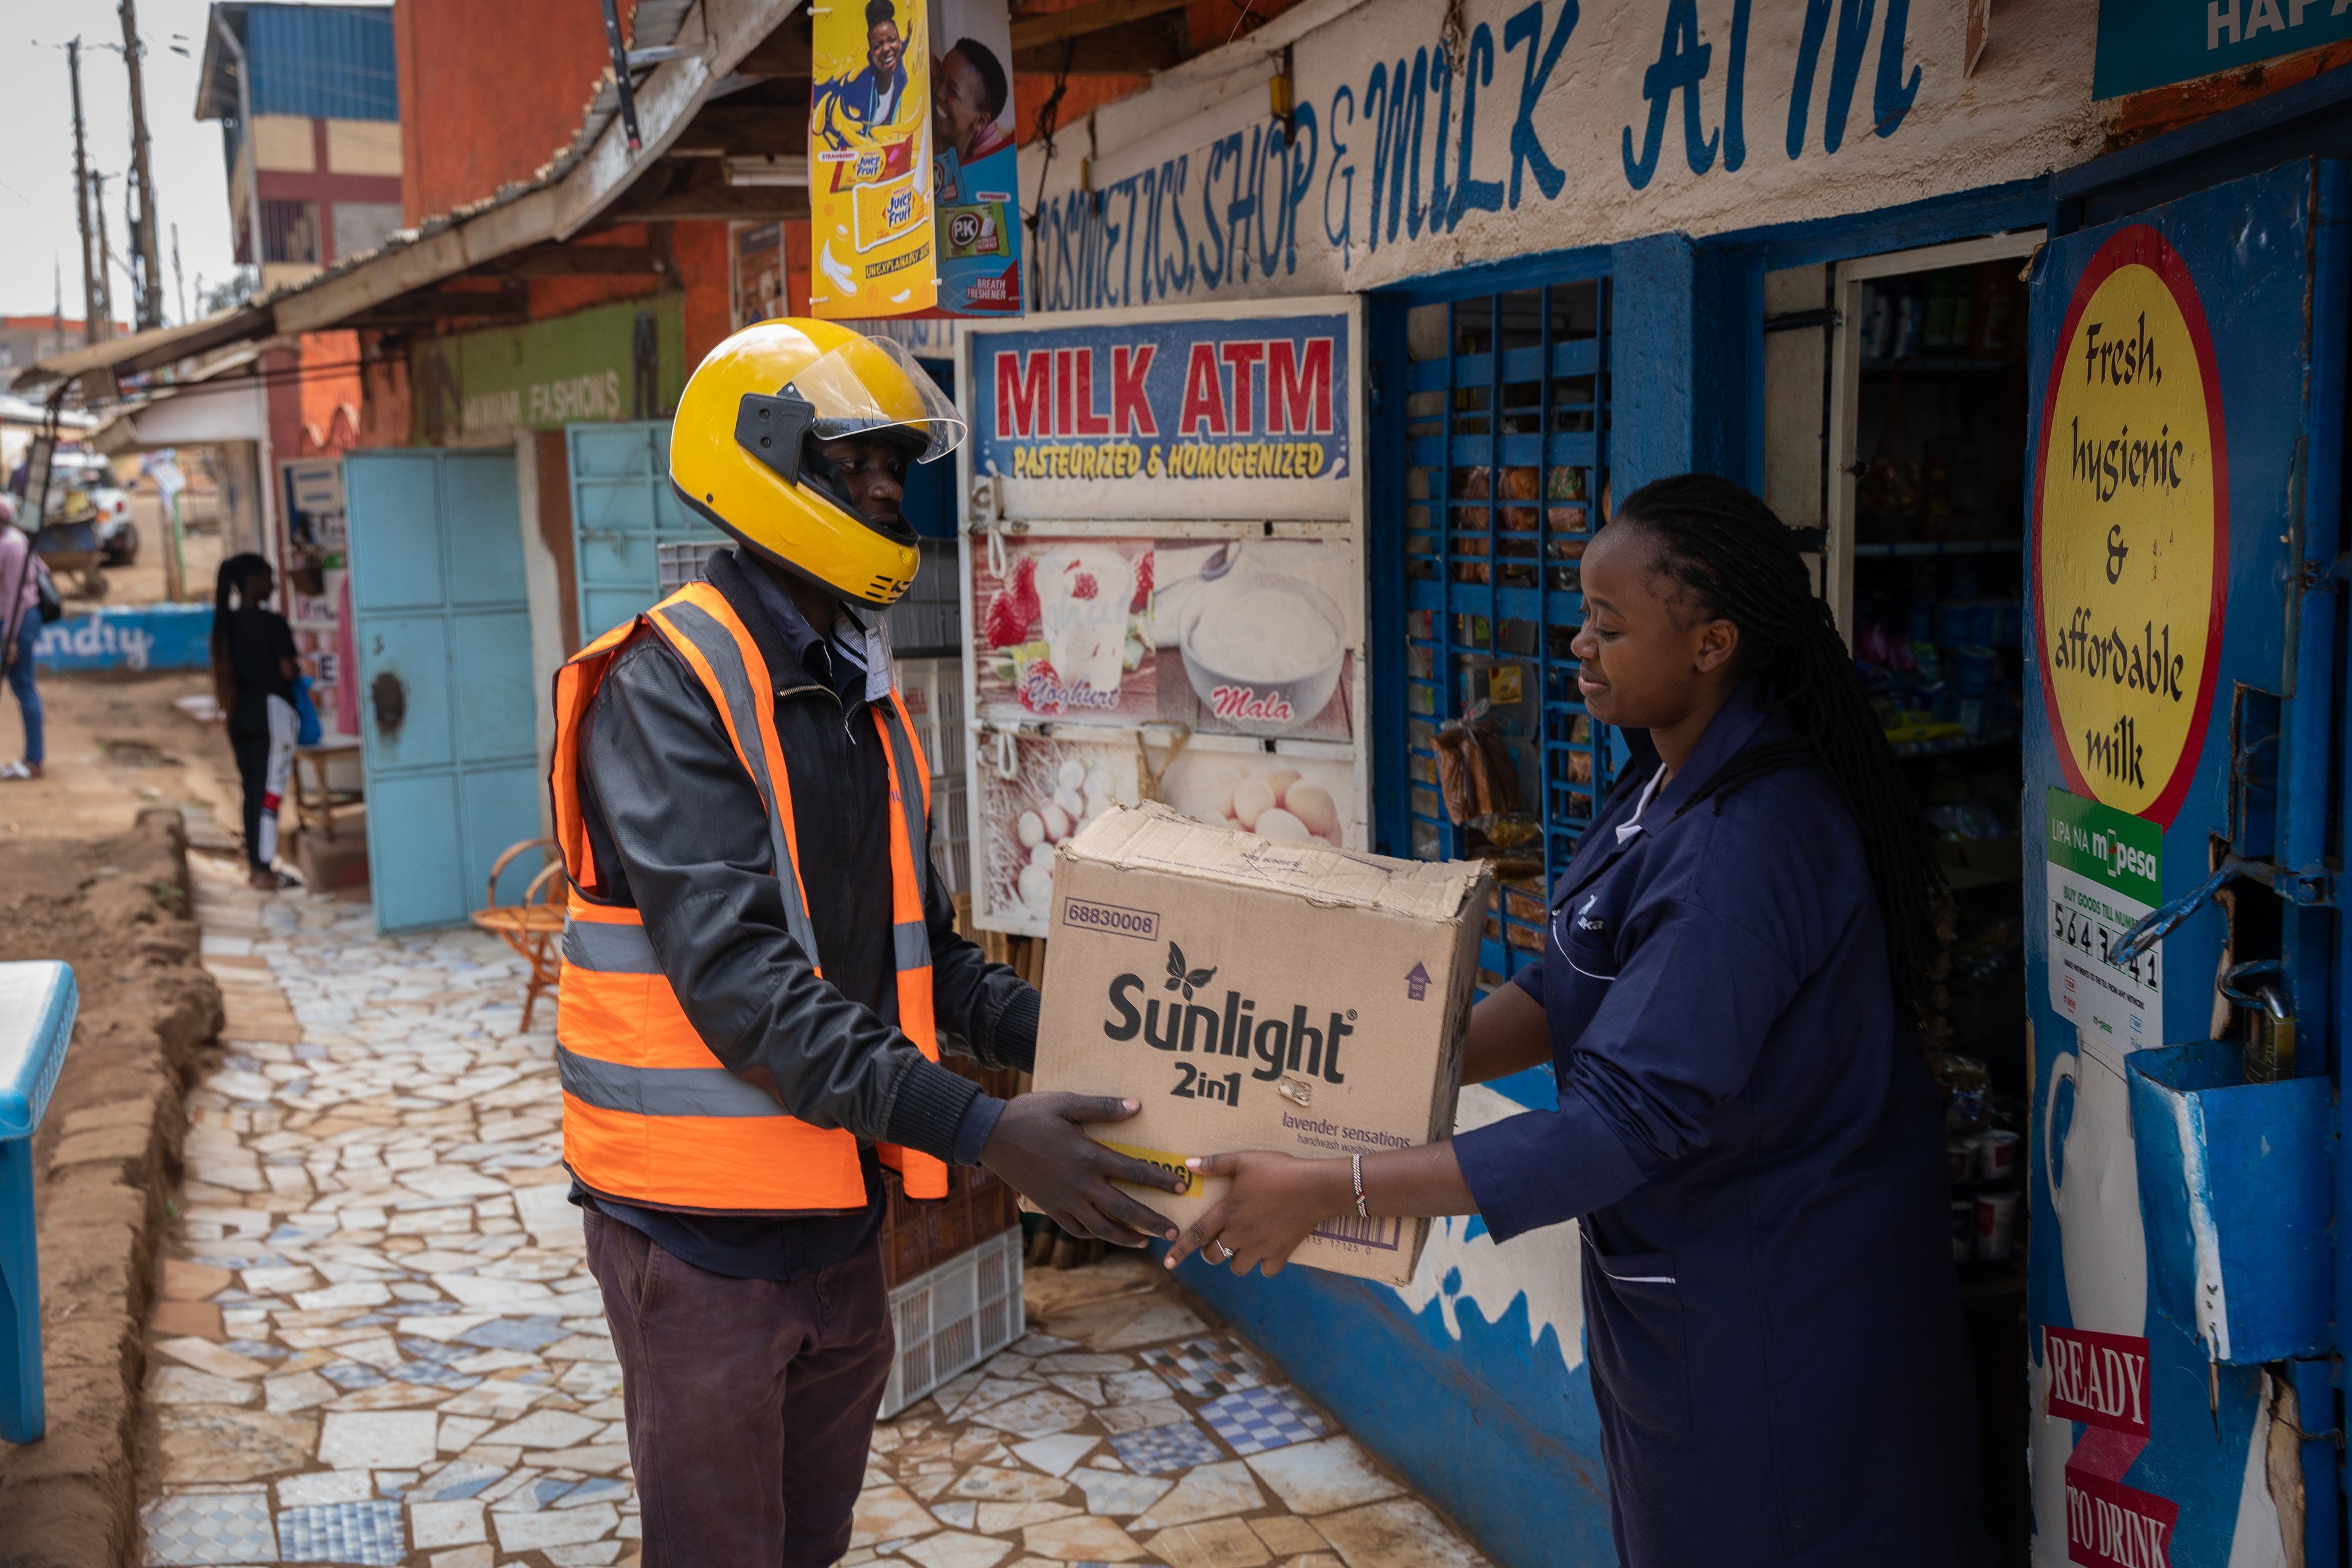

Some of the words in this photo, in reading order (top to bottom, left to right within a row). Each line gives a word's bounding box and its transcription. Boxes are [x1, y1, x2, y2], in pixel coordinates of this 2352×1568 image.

[1198, 101, 1319, 289] SHOP
[1324, 85, 1354, 271] &
[1363, 0, 1580, 254] MILK
[967, 288, 1006, 300] FRESHENER
[977, 278, 1006, 289] BREATH
[2085, 310, 2162, 386] Fresh,
[530, 370, 620, 419] FASHIONS
[995, 344, 1159, 440] MILK
[1178, 337, 1335, 437] ATM
[1012, 444, 1142, 480] PASTEURIZED
[1146, 445, 1162, 477] &
[1166, 442, 1324, 478] HOMOGENIZED
[2071, 416, 2183, 502] hygienic
[2106, 524, 2128, 585] &
[2055, 606, 2183, 703] affordable
[1028, 676, 1119, 710] Yoghurt
[1212, 685, 1293, 722] Mala
[2085, 715, 2144, 791] milk
[2052, 818, 2071, 847] LIPA
[2074, 824, 2089, 854] NA
[1068, 903, 1153, 935] 68830008
[2064, 885, 2077, 903] BUY
[2077, 891, 2101, 915] GOODS
[1170, 1062, 1242, 1107] 2in1
[1282, 1110, 1340, 1137] lavender
[1341, 1126, 1411, 1149] sensations
[1297, 1133, 1340, 1151] handwash
[2050, 1336, 2145, 1425] READY
[2066, 1485, 2094, 1550] TO
[2095, 1497, 2166, 1568] DRINK
